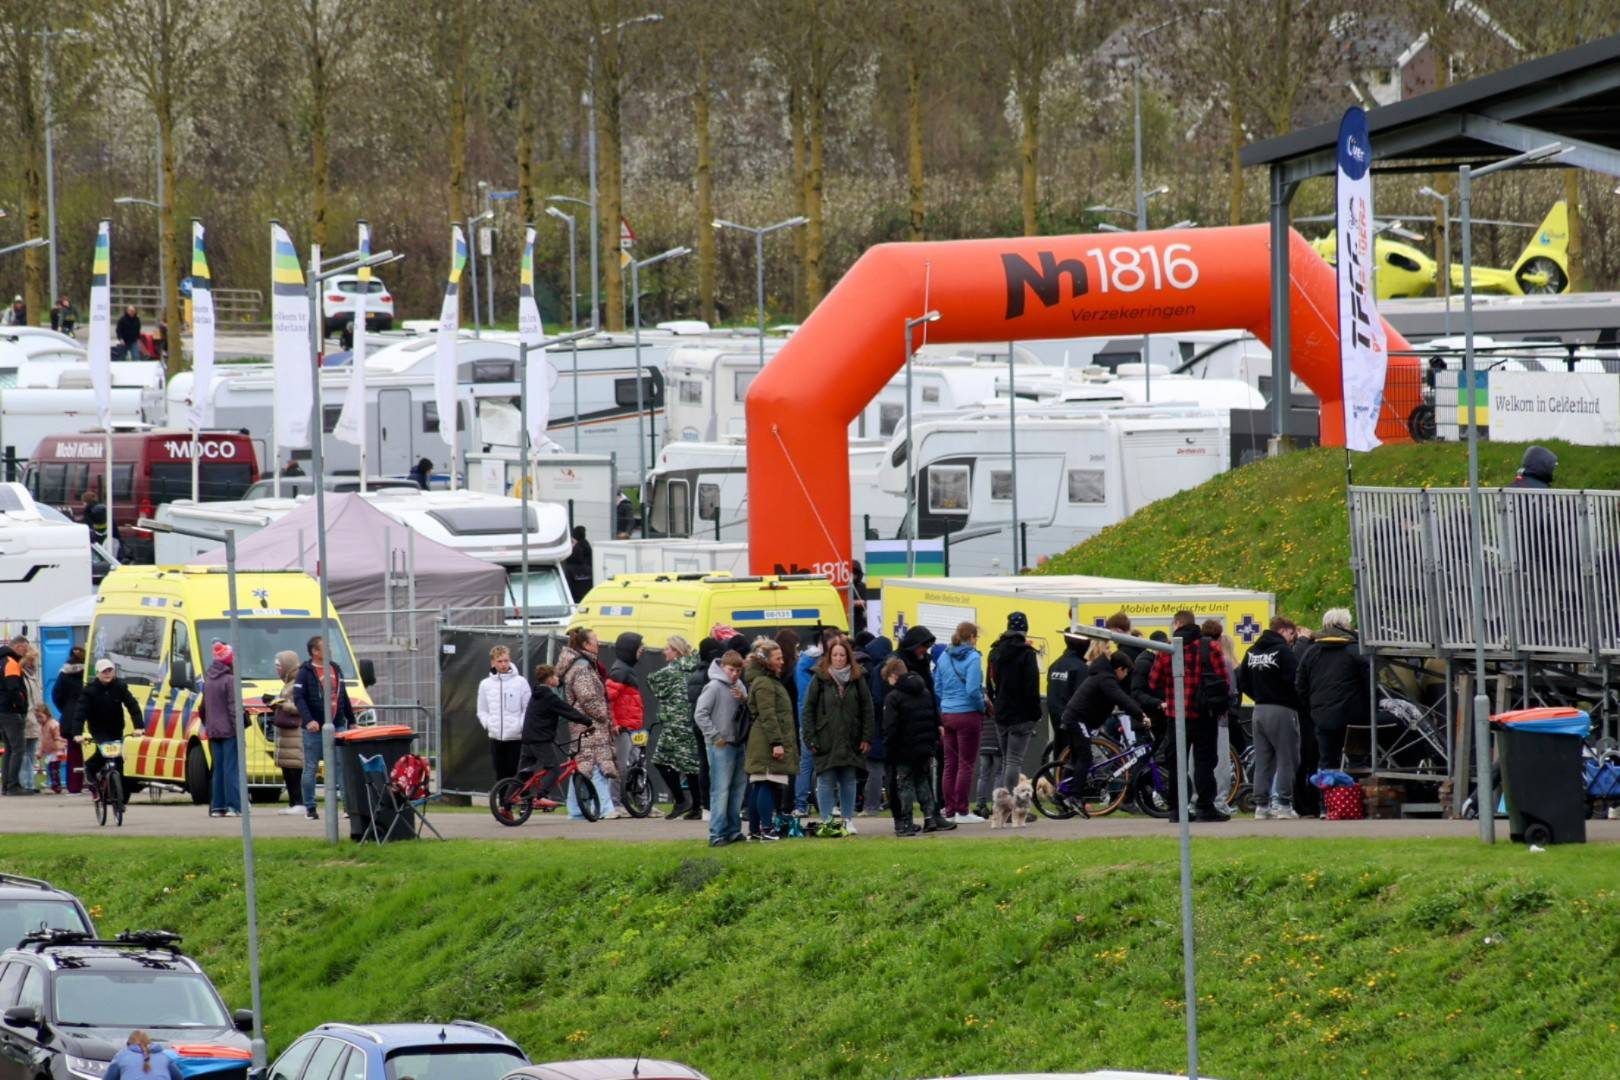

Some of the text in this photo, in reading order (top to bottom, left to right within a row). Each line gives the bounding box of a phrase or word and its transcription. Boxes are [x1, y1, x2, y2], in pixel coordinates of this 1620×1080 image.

[1071, 304, 1196, 322] Verzekeringen
[1496, 395, 1600, 414] Welkom in Gelderland
[1121, 602, 1230, 614] Mobiele Medische Unit
